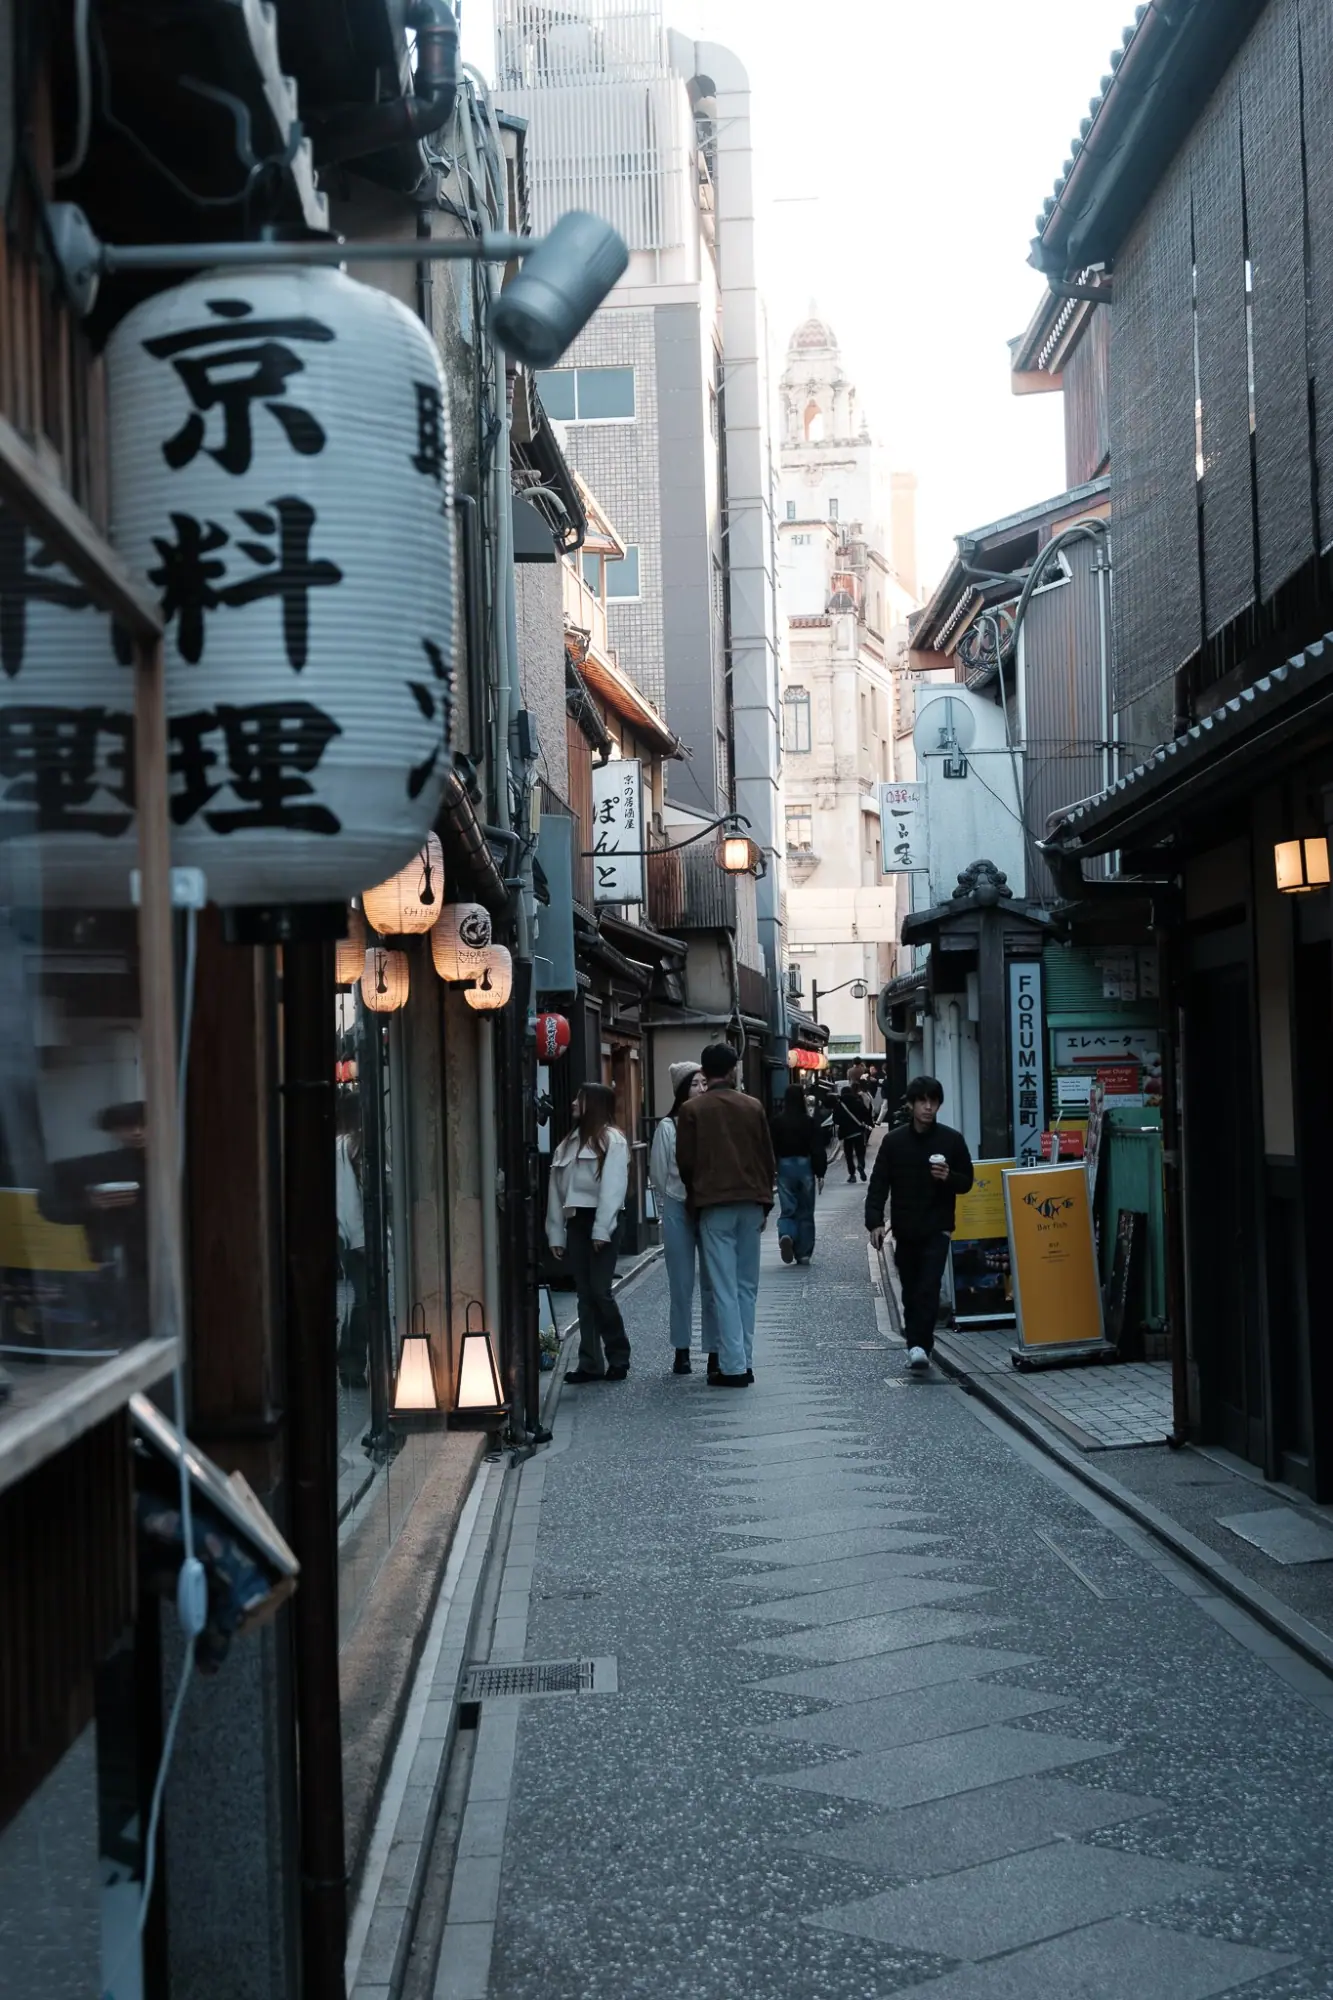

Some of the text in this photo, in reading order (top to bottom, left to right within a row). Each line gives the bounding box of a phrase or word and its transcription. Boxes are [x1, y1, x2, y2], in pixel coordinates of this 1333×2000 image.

[142, 298, 343, 836] 京料理
[623, 774, 635, 830] 京の居酒屋
[1067, 1035, 1147, 1048] エレベーター
[1037, 1223, 1050, 1232] Bar
